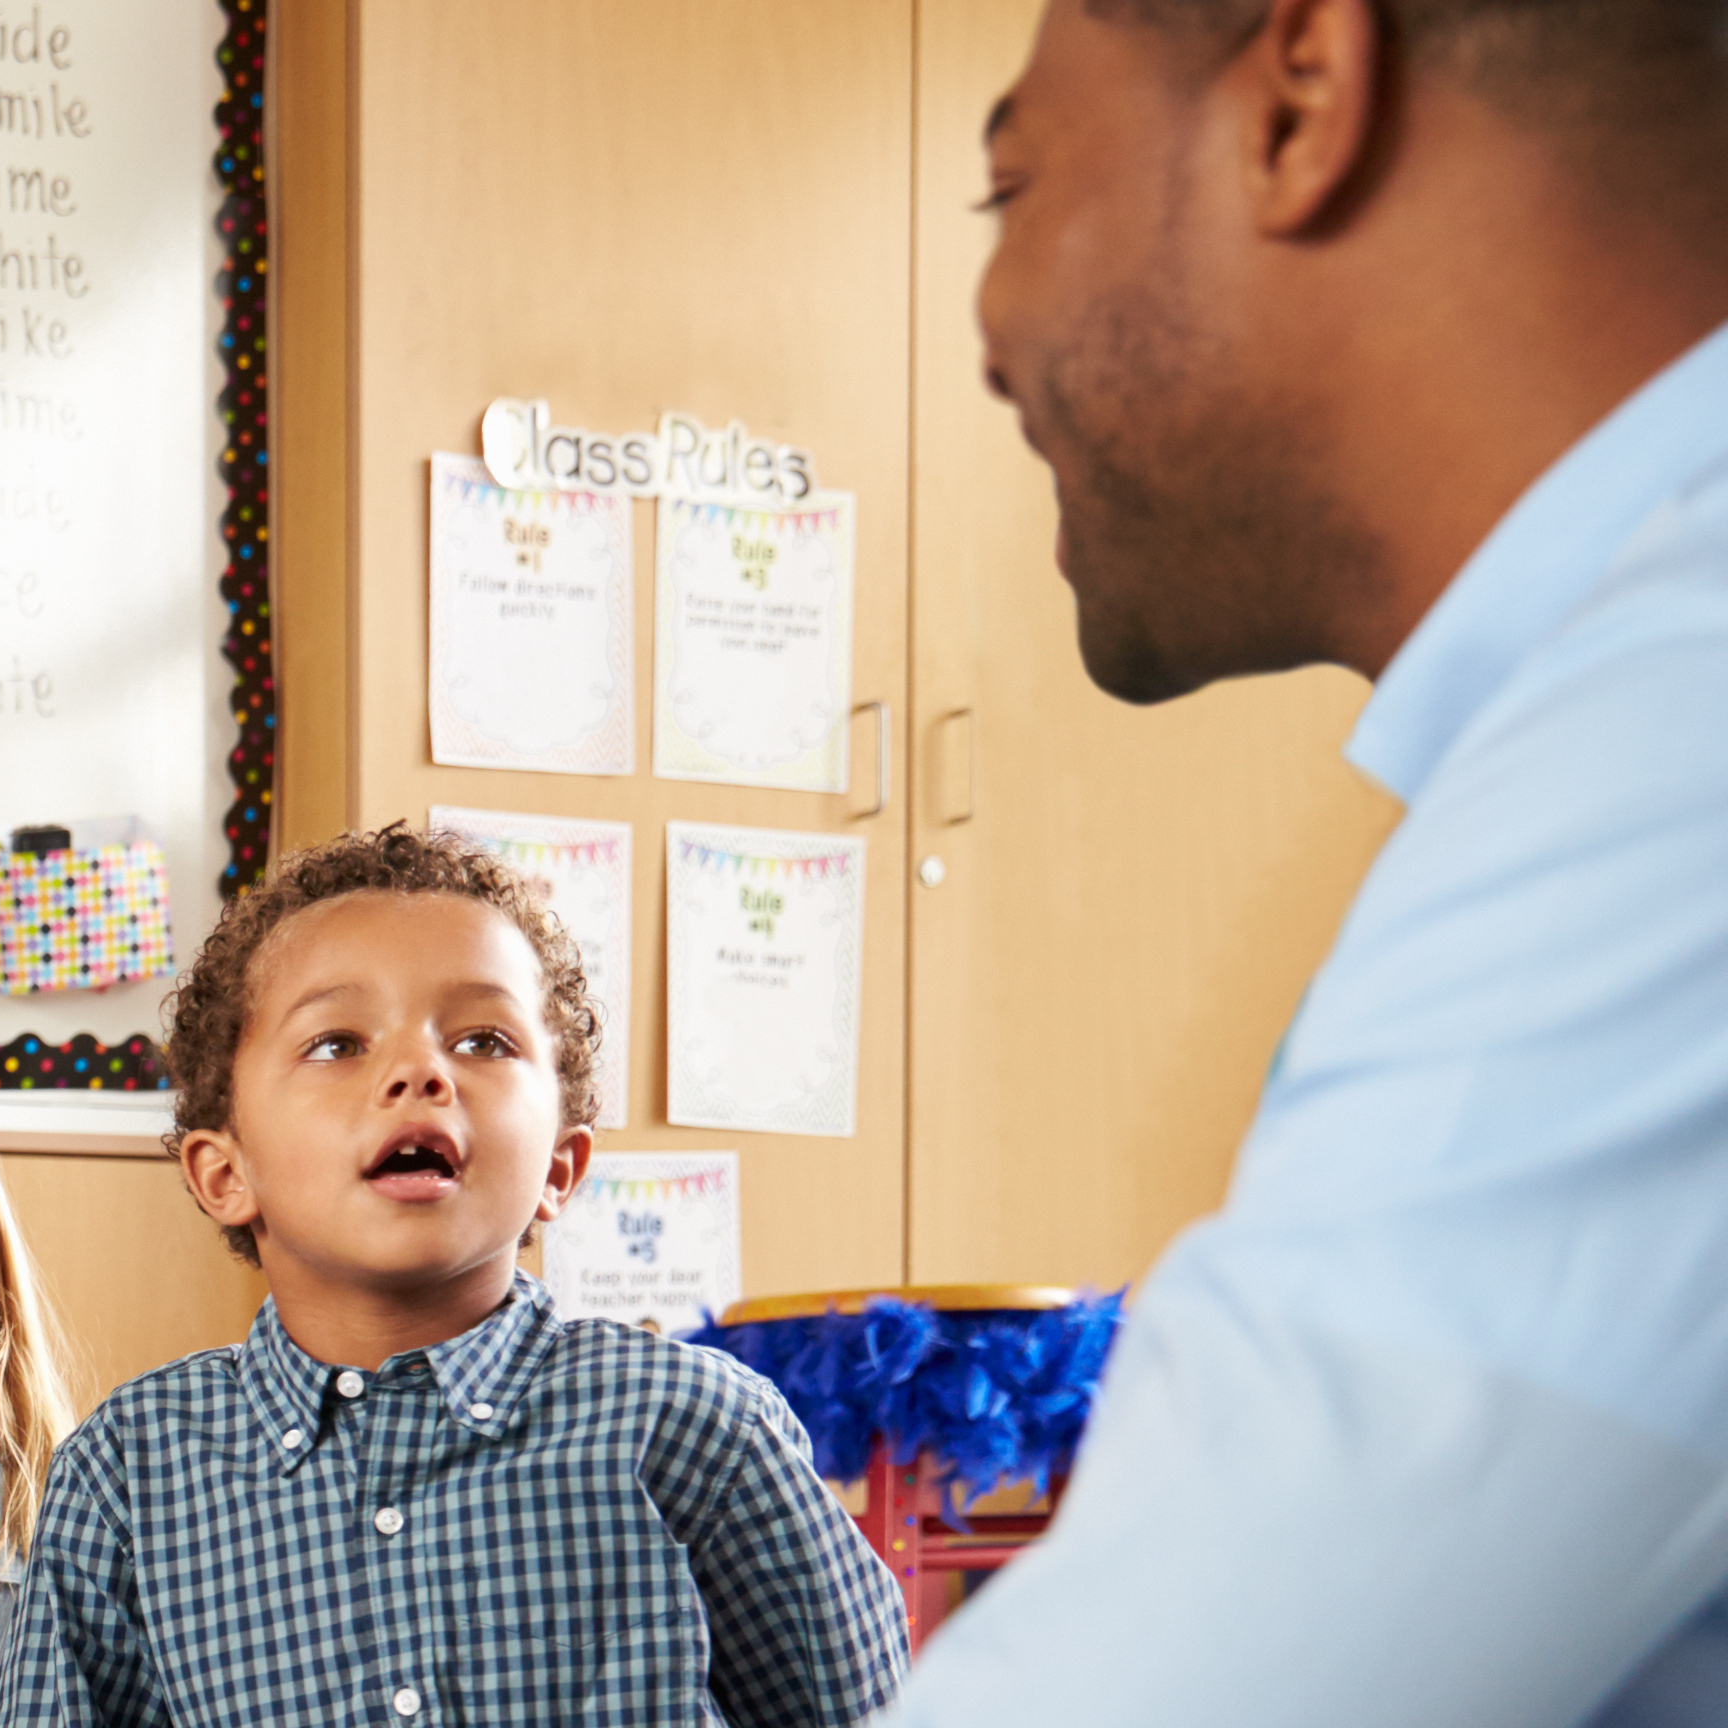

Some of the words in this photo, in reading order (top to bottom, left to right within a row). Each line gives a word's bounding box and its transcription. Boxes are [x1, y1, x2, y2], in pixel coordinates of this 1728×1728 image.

[661, 416, 810, 499] Rules
[503, 515, 550, 548] Rule
[731, 532, 776, 565] Rule
[458, 570, 508, 594] Follow
[514, 576, 597, 601] directions
[738, 885, 784, 917] Rule
[616, 1209, 663, 1238] Rule
